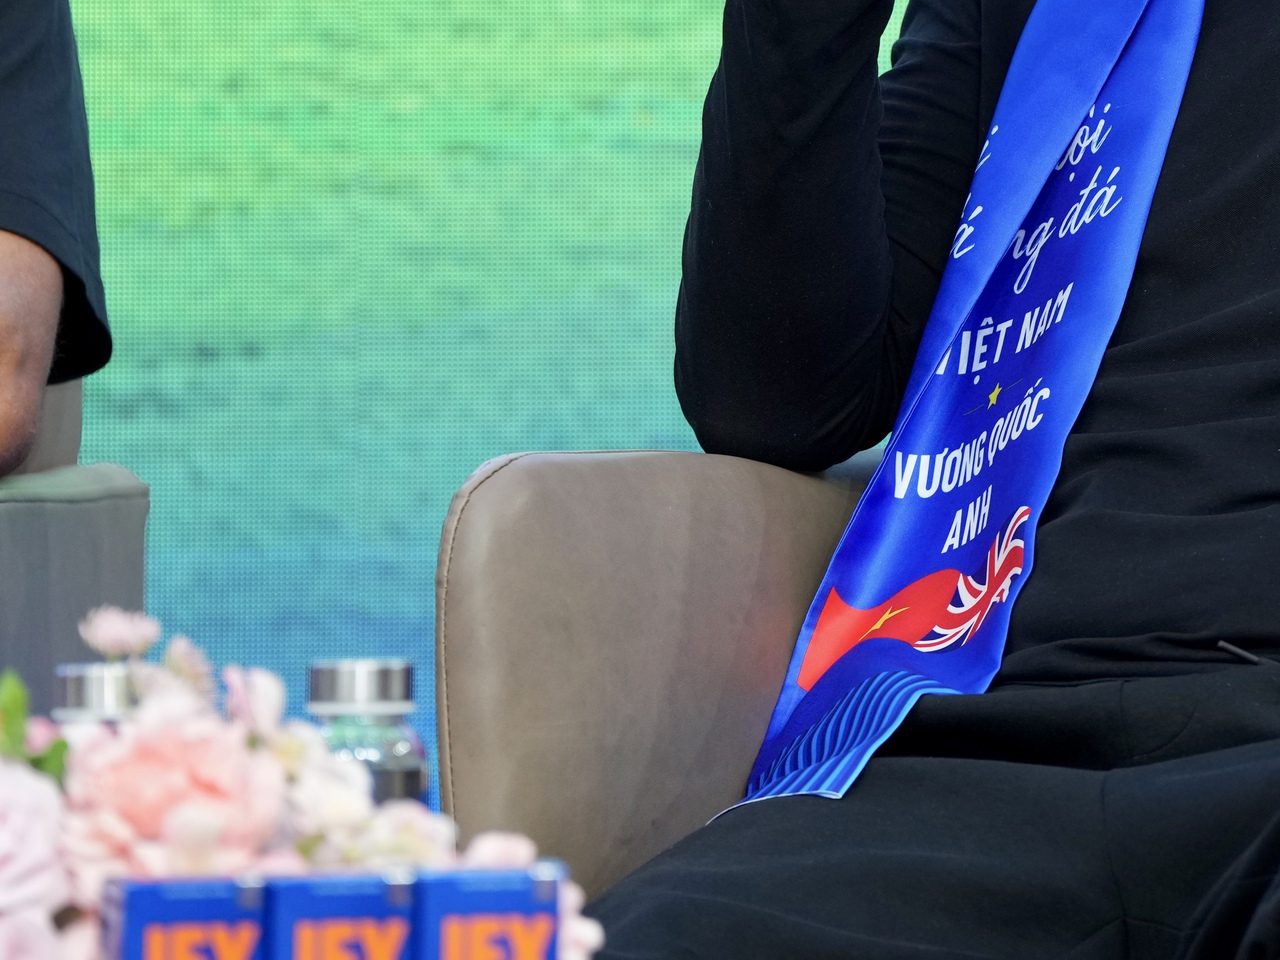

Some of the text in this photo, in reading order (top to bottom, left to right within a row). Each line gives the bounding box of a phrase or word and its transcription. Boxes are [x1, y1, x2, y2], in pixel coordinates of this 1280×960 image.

[1058, 164, 1124, 239] đá
[1015, 281, 1075, 354] NAM
[893, 376, 1051, 500] VƯƠNG QUỐC
[940, 484, 993, 554] ANH
